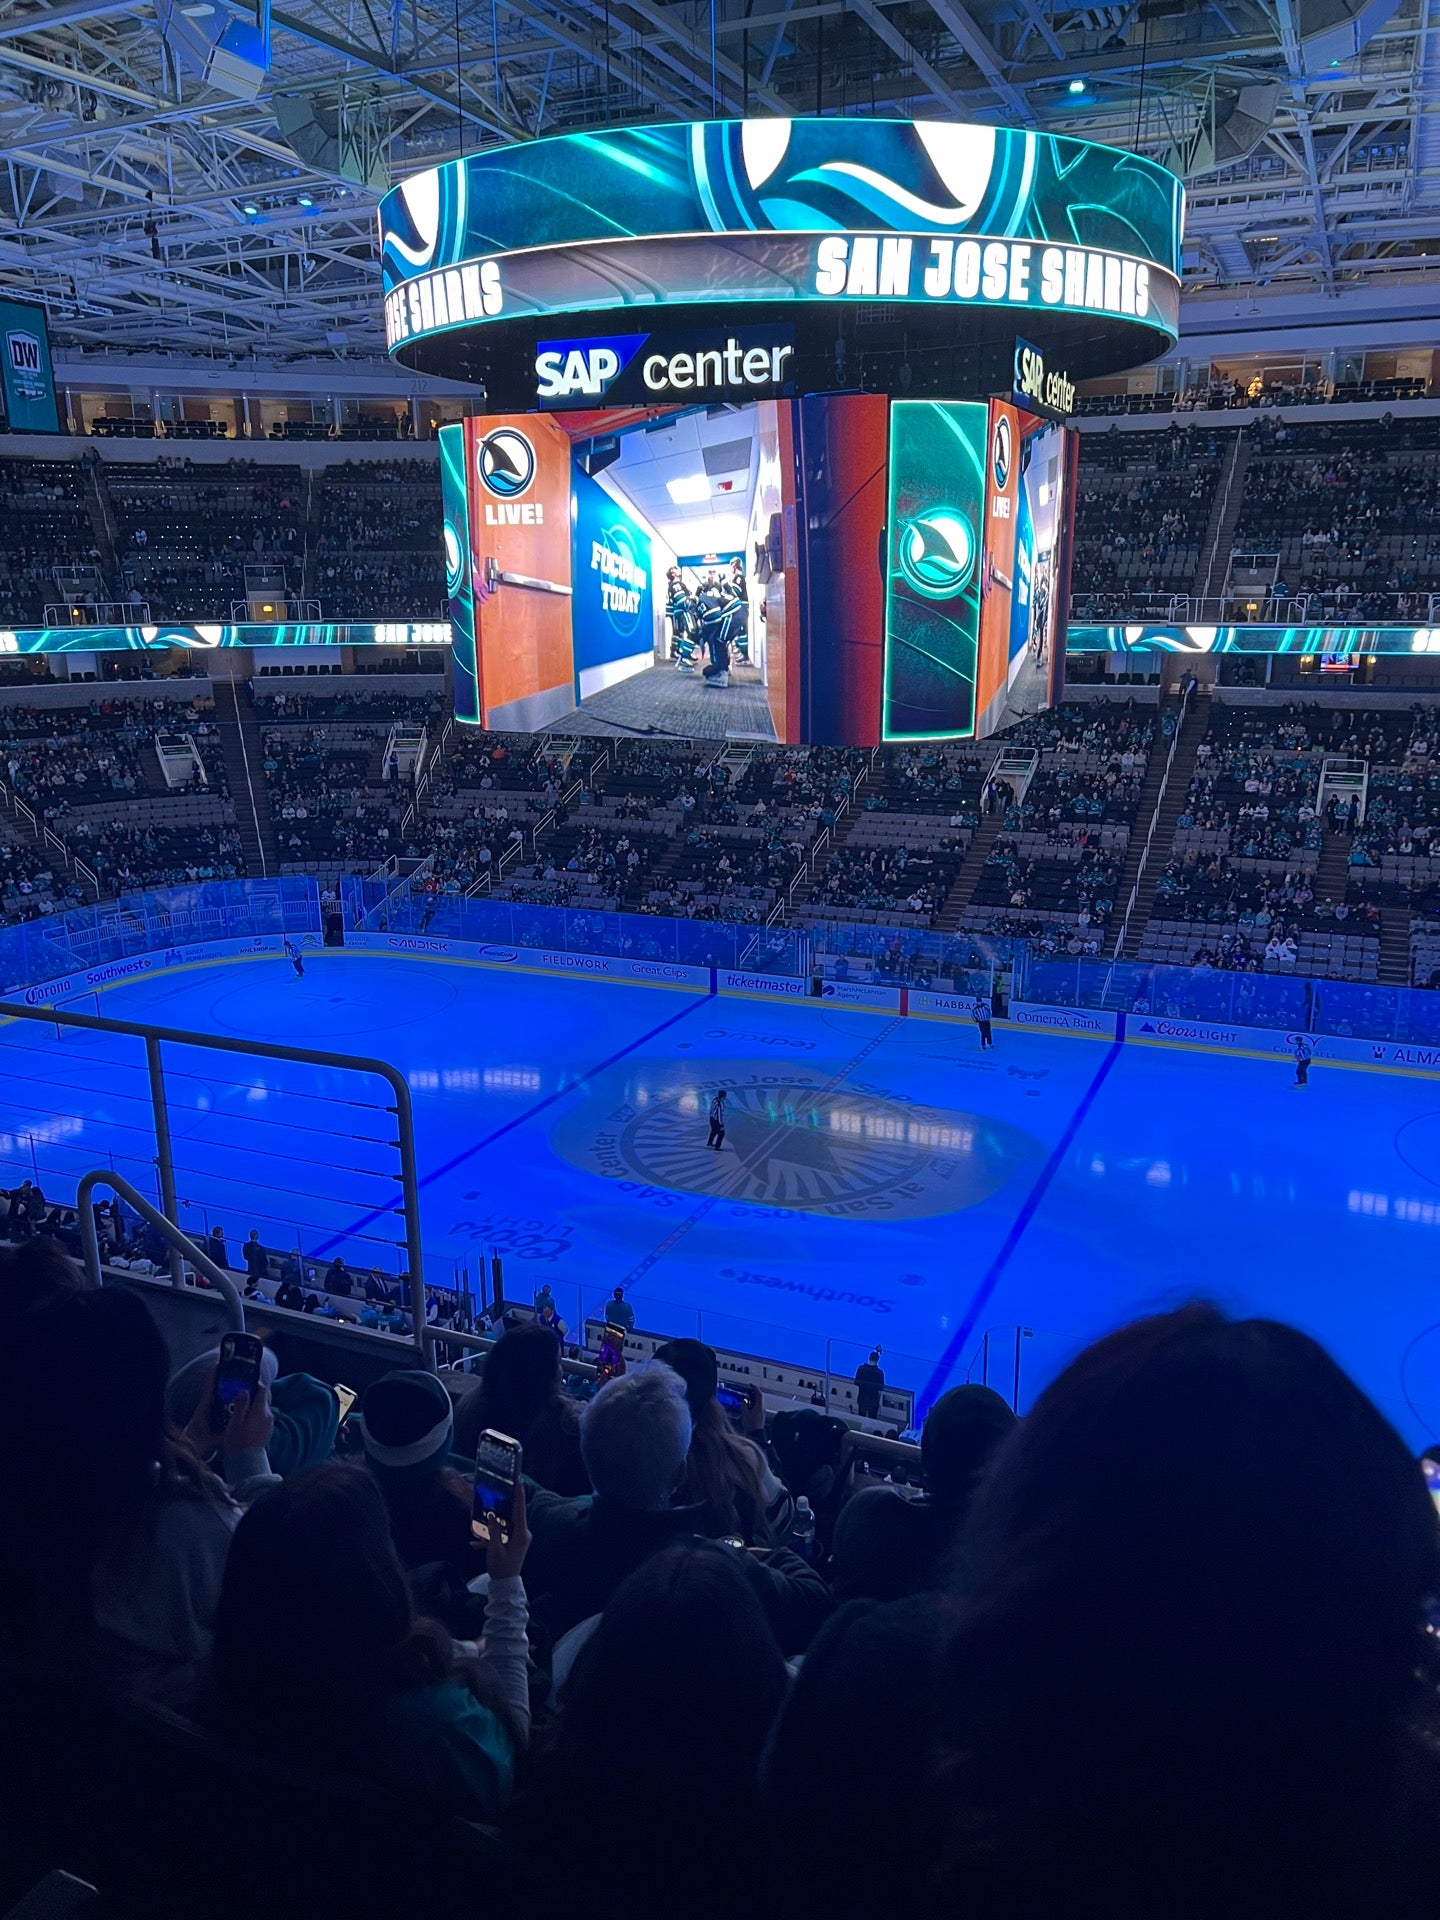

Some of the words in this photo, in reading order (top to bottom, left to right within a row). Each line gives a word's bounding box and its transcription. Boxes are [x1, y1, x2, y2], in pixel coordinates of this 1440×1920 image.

[815, 236, 913, 296] SAN
[923, 239, 1032, 301] JOSE
[1040, 247, 1150, 318] SHARKS
[408, 261, 503, 334] SHARKS
[11, 340, 38, 369] DW
[535, 348, 619, 397] SAP
[643, 338, 792, 391] center
[1021, 347, 1044, 400] SAP
[1046, 371, 1076, 413] center
[485, 503, 544, 526] LIVE!
[600, 581, 641, 614] TODAY
[388, 938, 449, 952] SANDISK
[86, 959, 144, 985] Southwest
[543, 955, 609, 971] FIELDWORK
[631, 963, 662, 976] Great
[663, 966, 688, 979] Clips
[25, 980, 71, 1006] Corona
[727, 974, 804, 994] ticketmaster
[1073, 1019, 1102, 1030] Bank
[1156, 1021, 1198, 1038] Coors
[1199, 1029, 1238, 1042] LIGHT
[743, 1074, 814, 1086] Jose
[735, 1271, 897, 1314] Southwest
